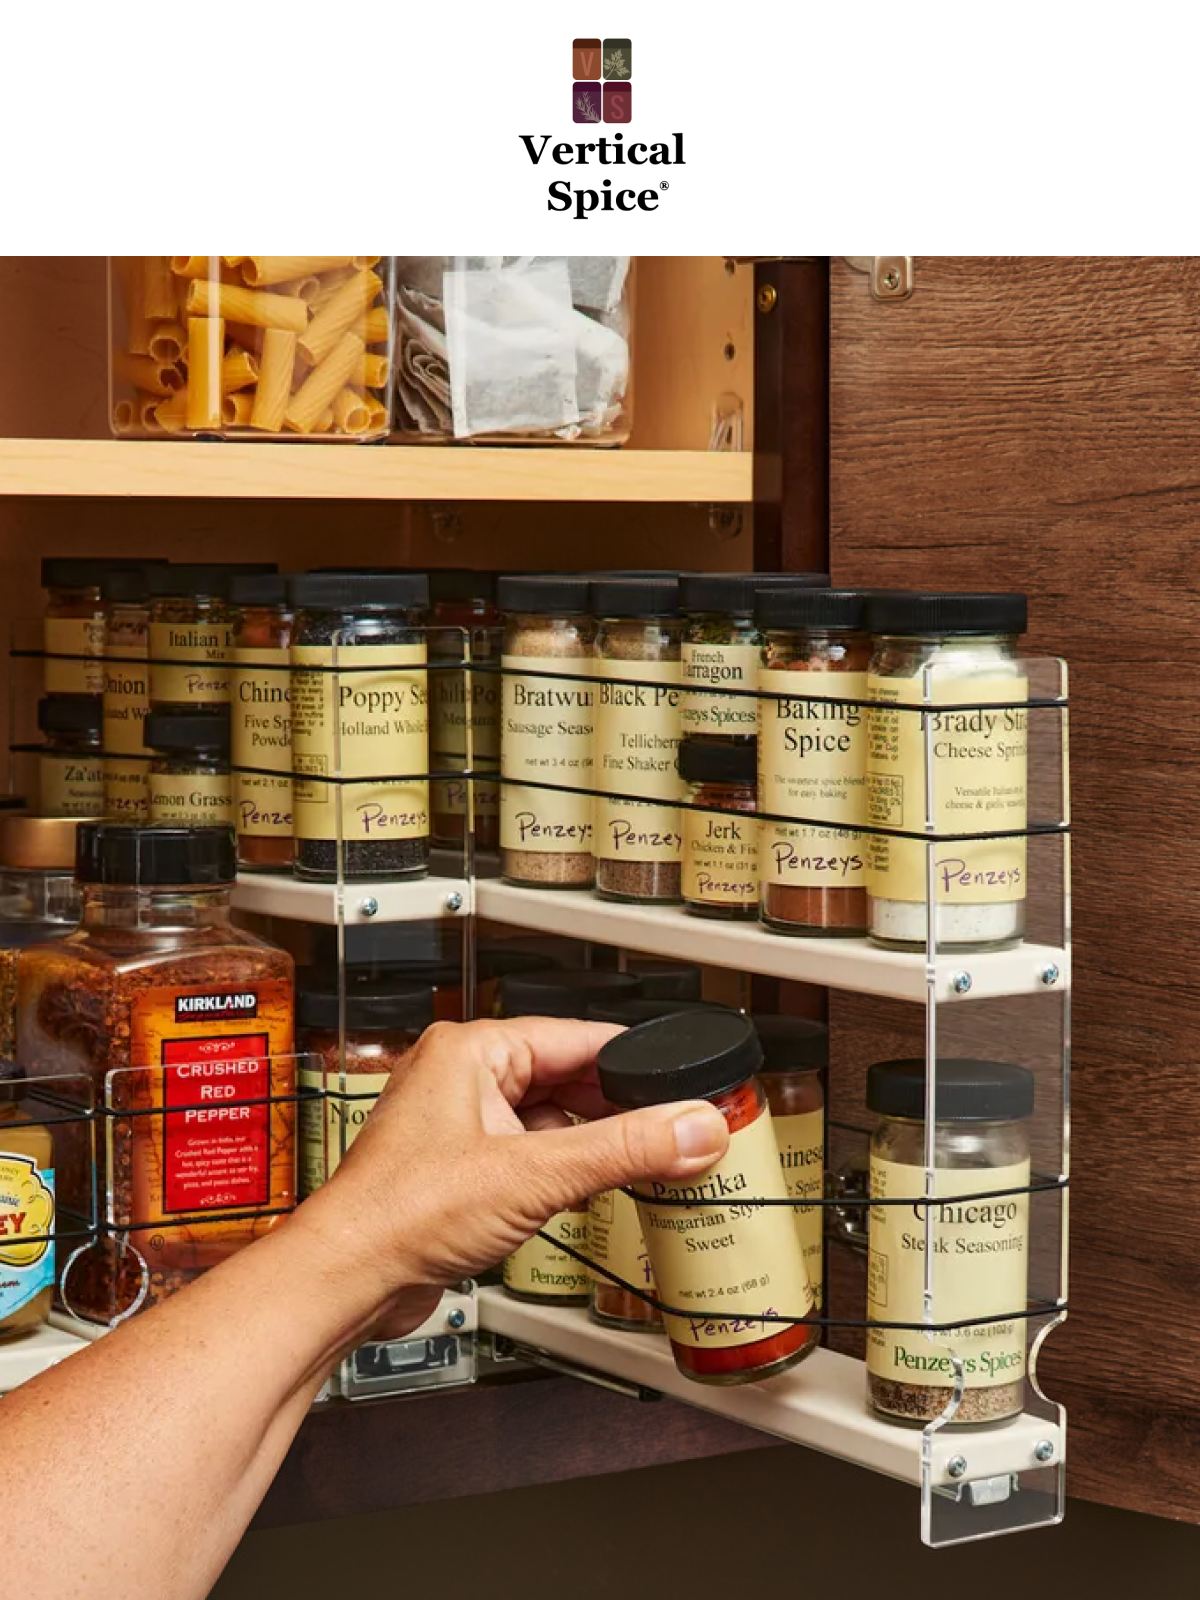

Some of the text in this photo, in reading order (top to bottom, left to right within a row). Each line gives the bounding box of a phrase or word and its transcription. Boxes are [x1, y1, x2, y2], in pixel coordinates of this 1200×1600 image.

[692, 649, 725, 664] French
[340, 686, 404, 714] Poppy
[245, 714, 269, 728] Five
[711, 705, 757, 728] Spices
[778, 697, 861, 727] Baking
[507, 719, 553, 738] Sausage
[785, 726, 851, 758] Spice
[933, 742, 992, 758] Cheese
[603, 754, 624, 769] Fine
[627, 756, 670, 772] Shaker
[190, 792, 232, 807] Grass
[705, 820, 742, 840] Jerk
[771, 841, 864, 877] Penzeys
[696, 872, 755, 894] Penzeys
[936, 858, 1021, 893] Penzeys
[177, 994, 257, 1012] KIRKLAND
[177, 1060, 259, 1078] CRUSHED
[201, 1085, 236, 1099] RED
[185, 1106, 250, 1124] PEPPER
[650, 1172, 748, 1210] Paprika
[648, 1211, 726, 1234] Hungarian
[685, 1232, 735, 1254] Sweet
[954, 1234, 1024, 1256] Seasoning
[531, 1268, 587, 1291] Penzeys
[708, 1286, 724, 1299] 2.4
[726, 1283, 739, 1296] oz
